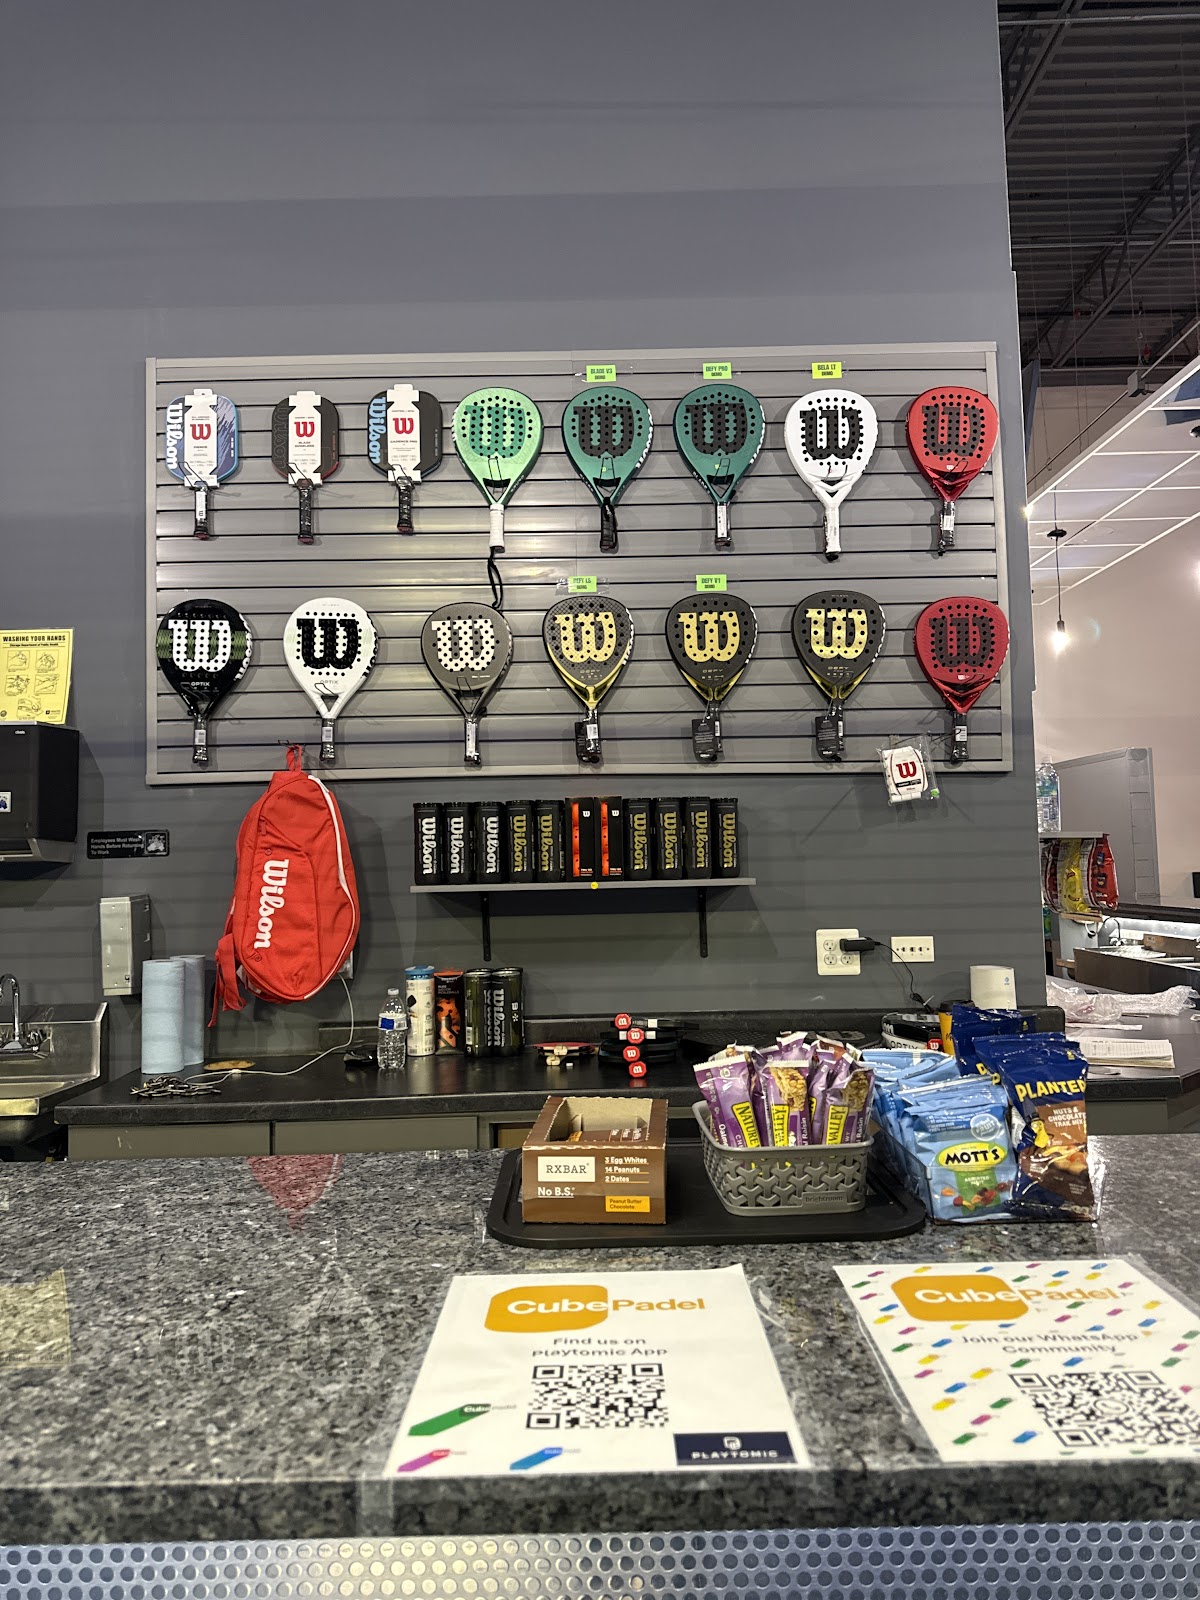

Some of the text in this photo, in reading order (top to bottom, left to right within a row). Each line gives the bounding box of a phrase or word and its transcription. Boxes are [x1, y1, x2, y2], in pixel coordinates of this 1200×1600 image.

[166, 403, 184, 470] Wilson
[367, 397, 386, 464] Wilson
[422, 816, 437, 875] Wilson
[450, 816, 464, 874] Wilson
[486, 816, 500, 874] Wilson
[513, 814, 527, 872] Wilson
[540, 814, 554, 872] Wilson
[633, 812, 647, 870] Wilson
[663, 811, 678, 870] Wilson
[694, 810, 708, 868] Wilson
[722, 812, 736, 869] Wilson
[253, 858, 290, 949] Wilson
[493, 988, 505, 1047] Wilson
[735, 1105, 760, 1146] NATURE
[1047, 1112, 1087, 1123] CHOCOLAT
[1052, 1107, 1072, 1115] NUTS
[1053, 1120, 1071, 1128] TRAIL
[610, 1157, 623, 1165] Egg
[623, 1156, 648, 1164] Whites
[538, 1187, 552, 1196] No
[805, 1194, 844, 1203] brightroom
[553, 1337, 592, 1345] Find
[631, 1348, 668, 1356] App
[962, 1335, 999, 1344] Join
[1037, 1333, 1139, 1344] WhatsApp
[1001, 1344, 1117, 1354] Community
[691, 1449, 779, 1460] PLAYTOMIC
